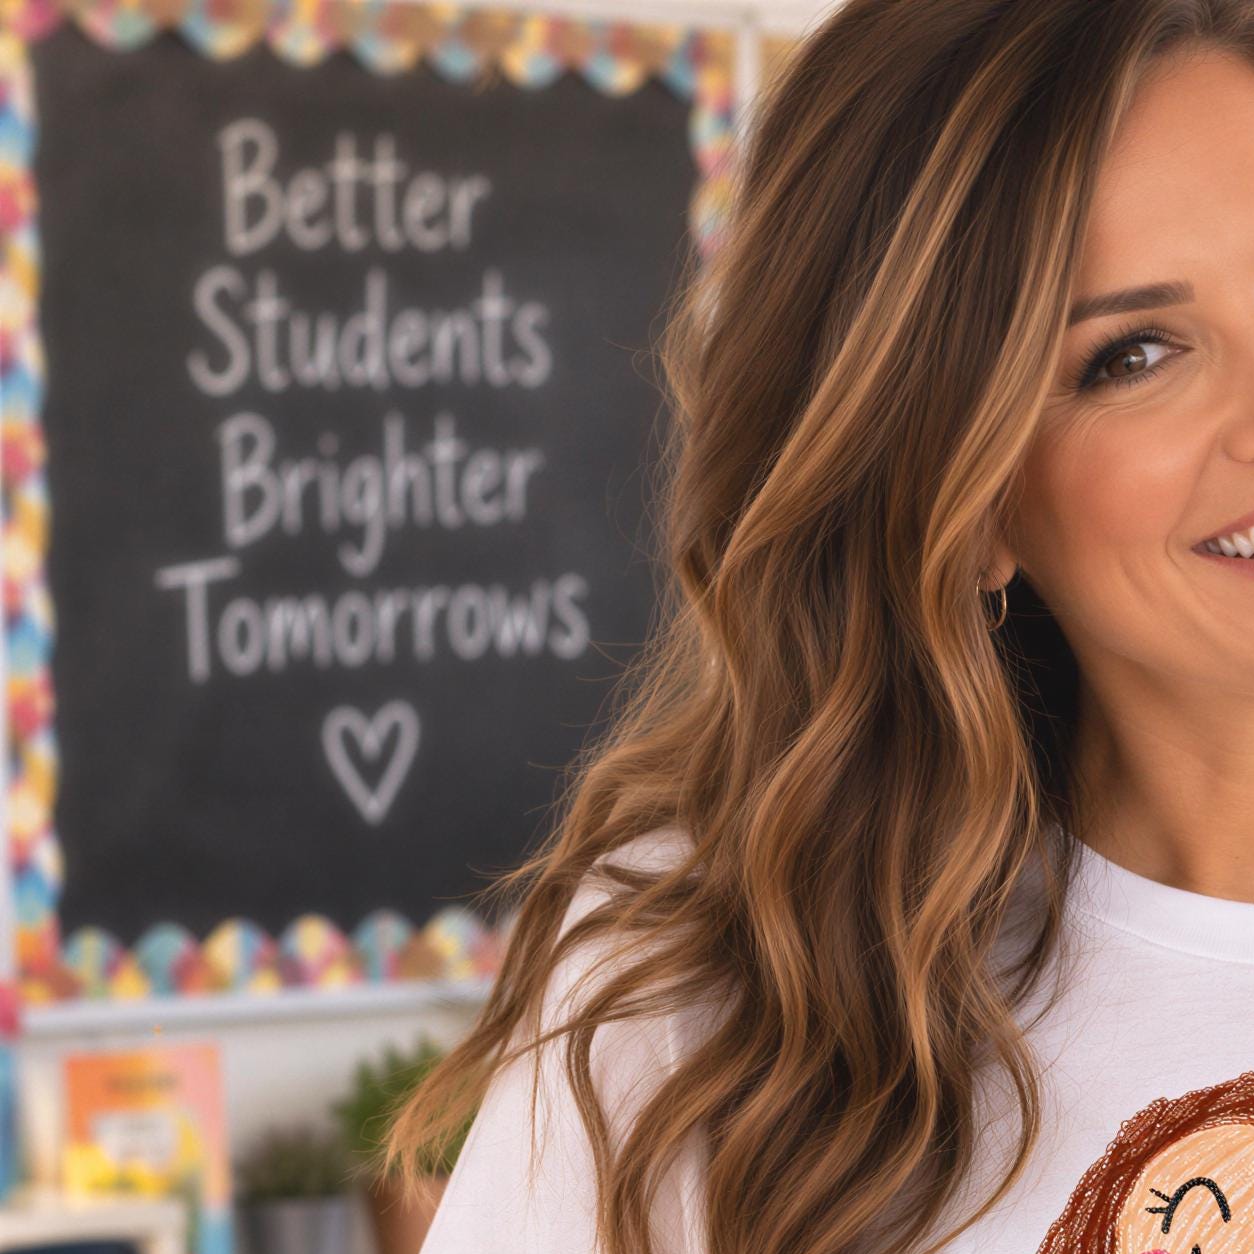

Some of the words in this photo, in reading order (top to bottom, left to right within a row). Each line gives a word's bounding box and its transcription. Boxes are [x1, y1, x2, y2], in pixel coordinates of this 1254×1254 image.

[218, 118, 489, 256] Better
[186, 266, 553, 396] Students
[219, 411, 545, 577] Brighter
[156, 555, 589, 683] Tomorrows
